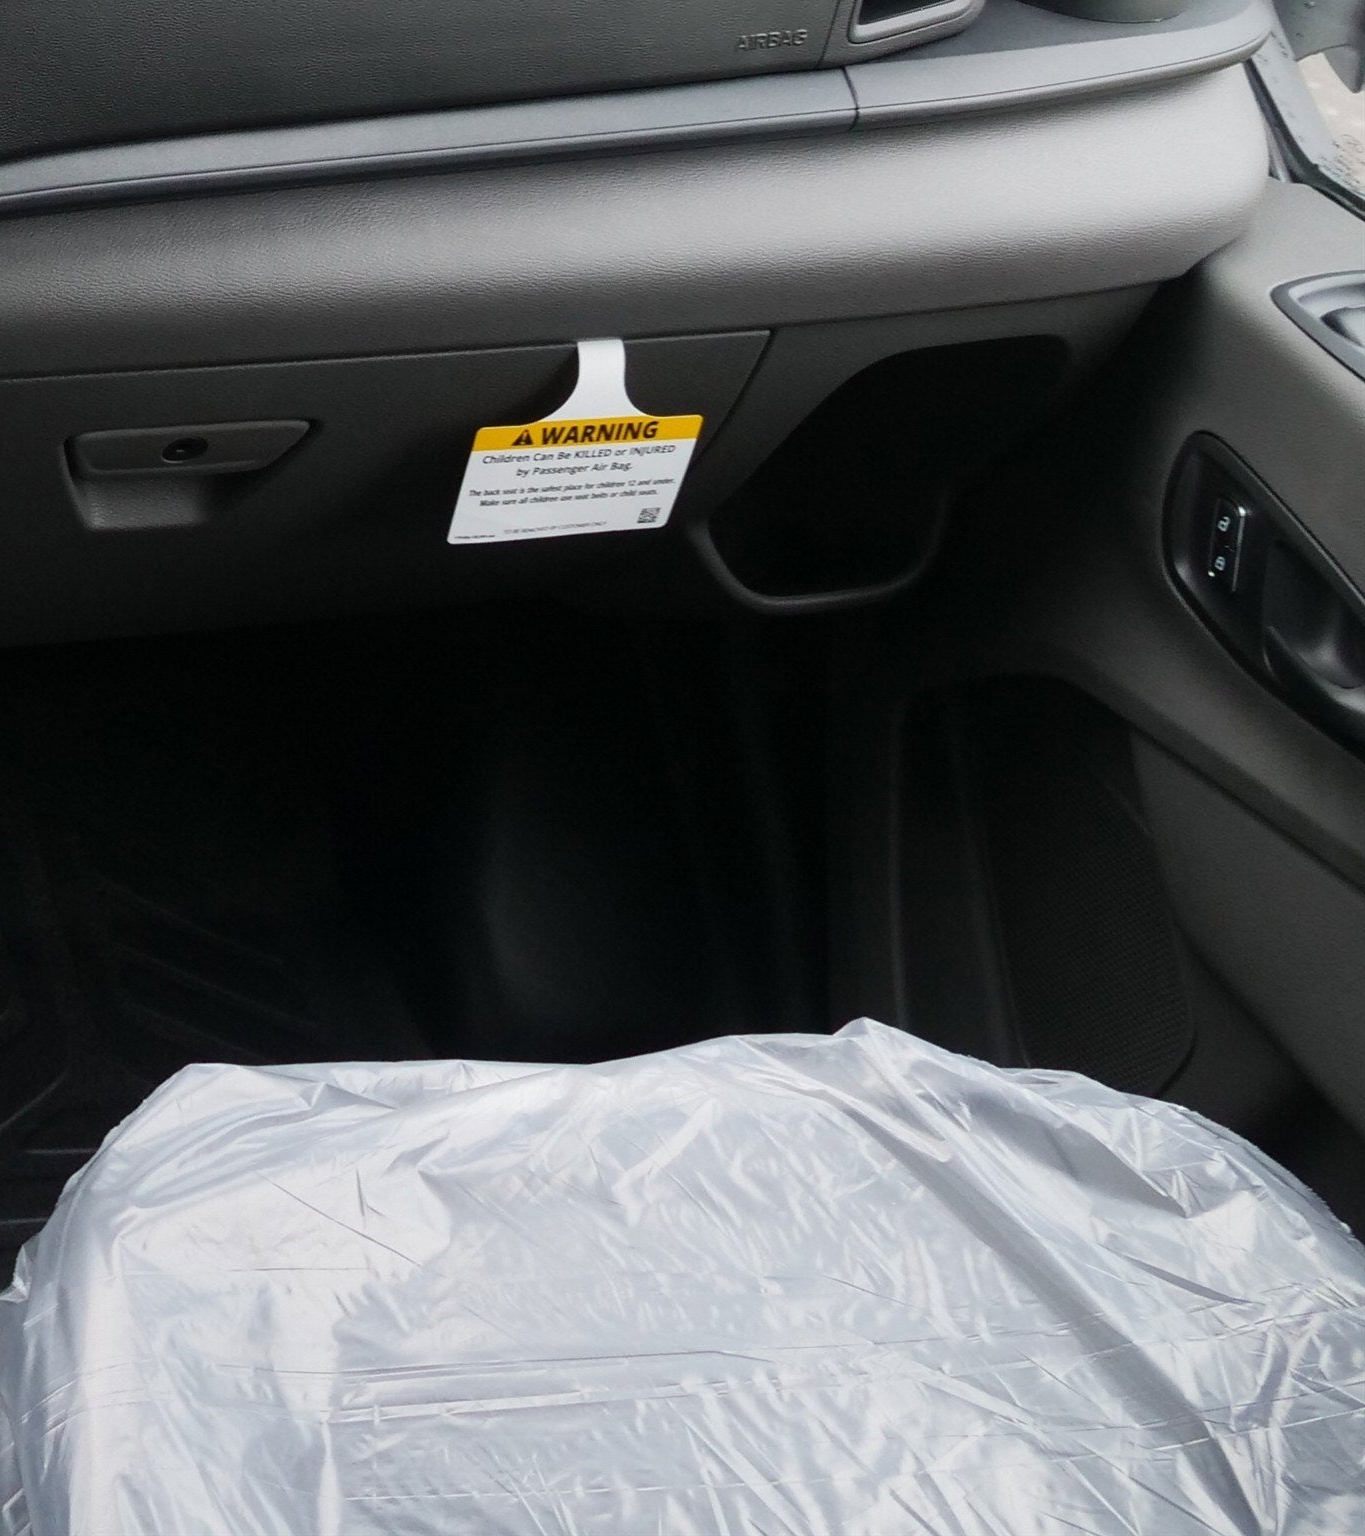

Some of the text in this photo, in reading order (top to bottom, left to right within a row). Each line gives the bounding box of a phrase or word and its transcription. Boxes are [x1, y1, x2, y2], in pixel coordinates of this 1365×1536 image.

[735, 28, 808, 50] AIRBAG
[541, 421, 659, 446] WARNING
[482, 444, 676, 465] Children Can Be KILLED or INJURED
[516, 468, 529, 478] by
[532, 464, 589, 476] Passenger
[591, 462, 608, 472] Air
